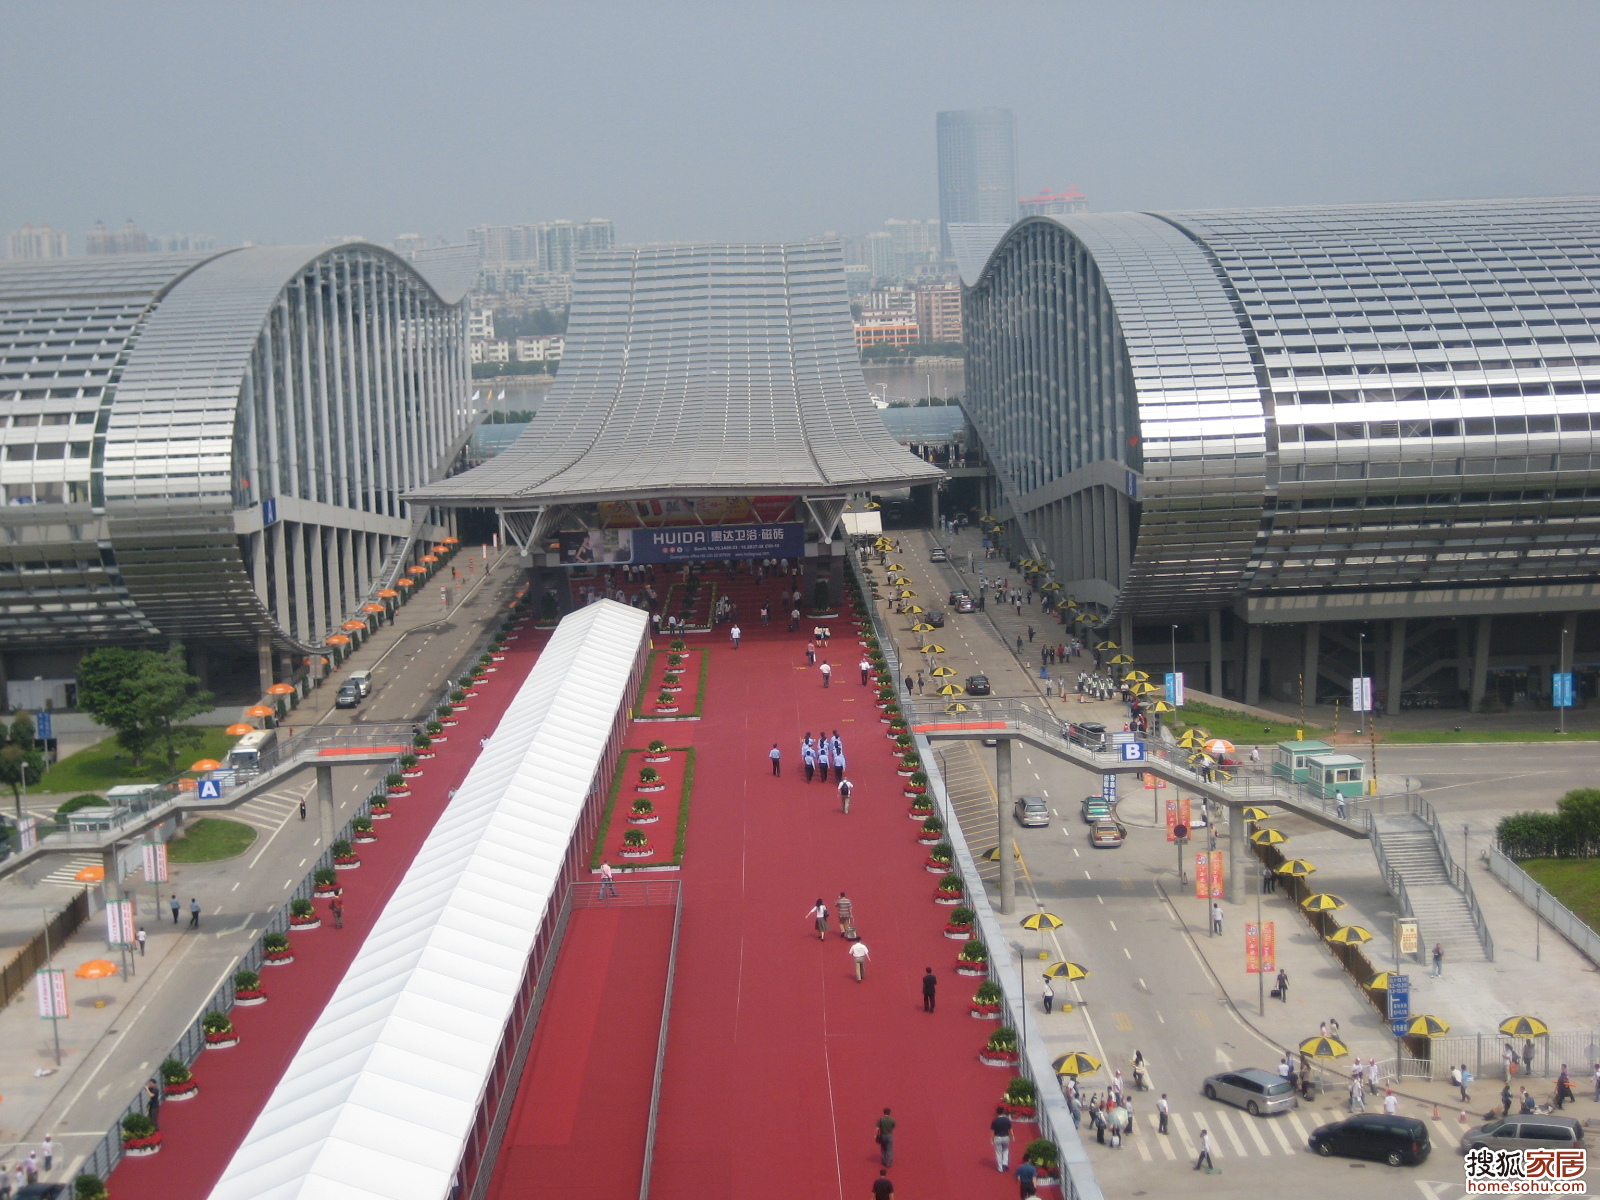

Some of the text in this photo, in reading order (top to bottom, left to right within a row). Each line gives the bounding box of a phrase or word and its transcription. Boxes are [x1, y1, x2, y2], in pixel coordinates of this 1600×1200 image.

[653, 531, 705, 545] HUIDA
[1126, 744, 1140, 759] B
[201, 781, 219, 797] A
